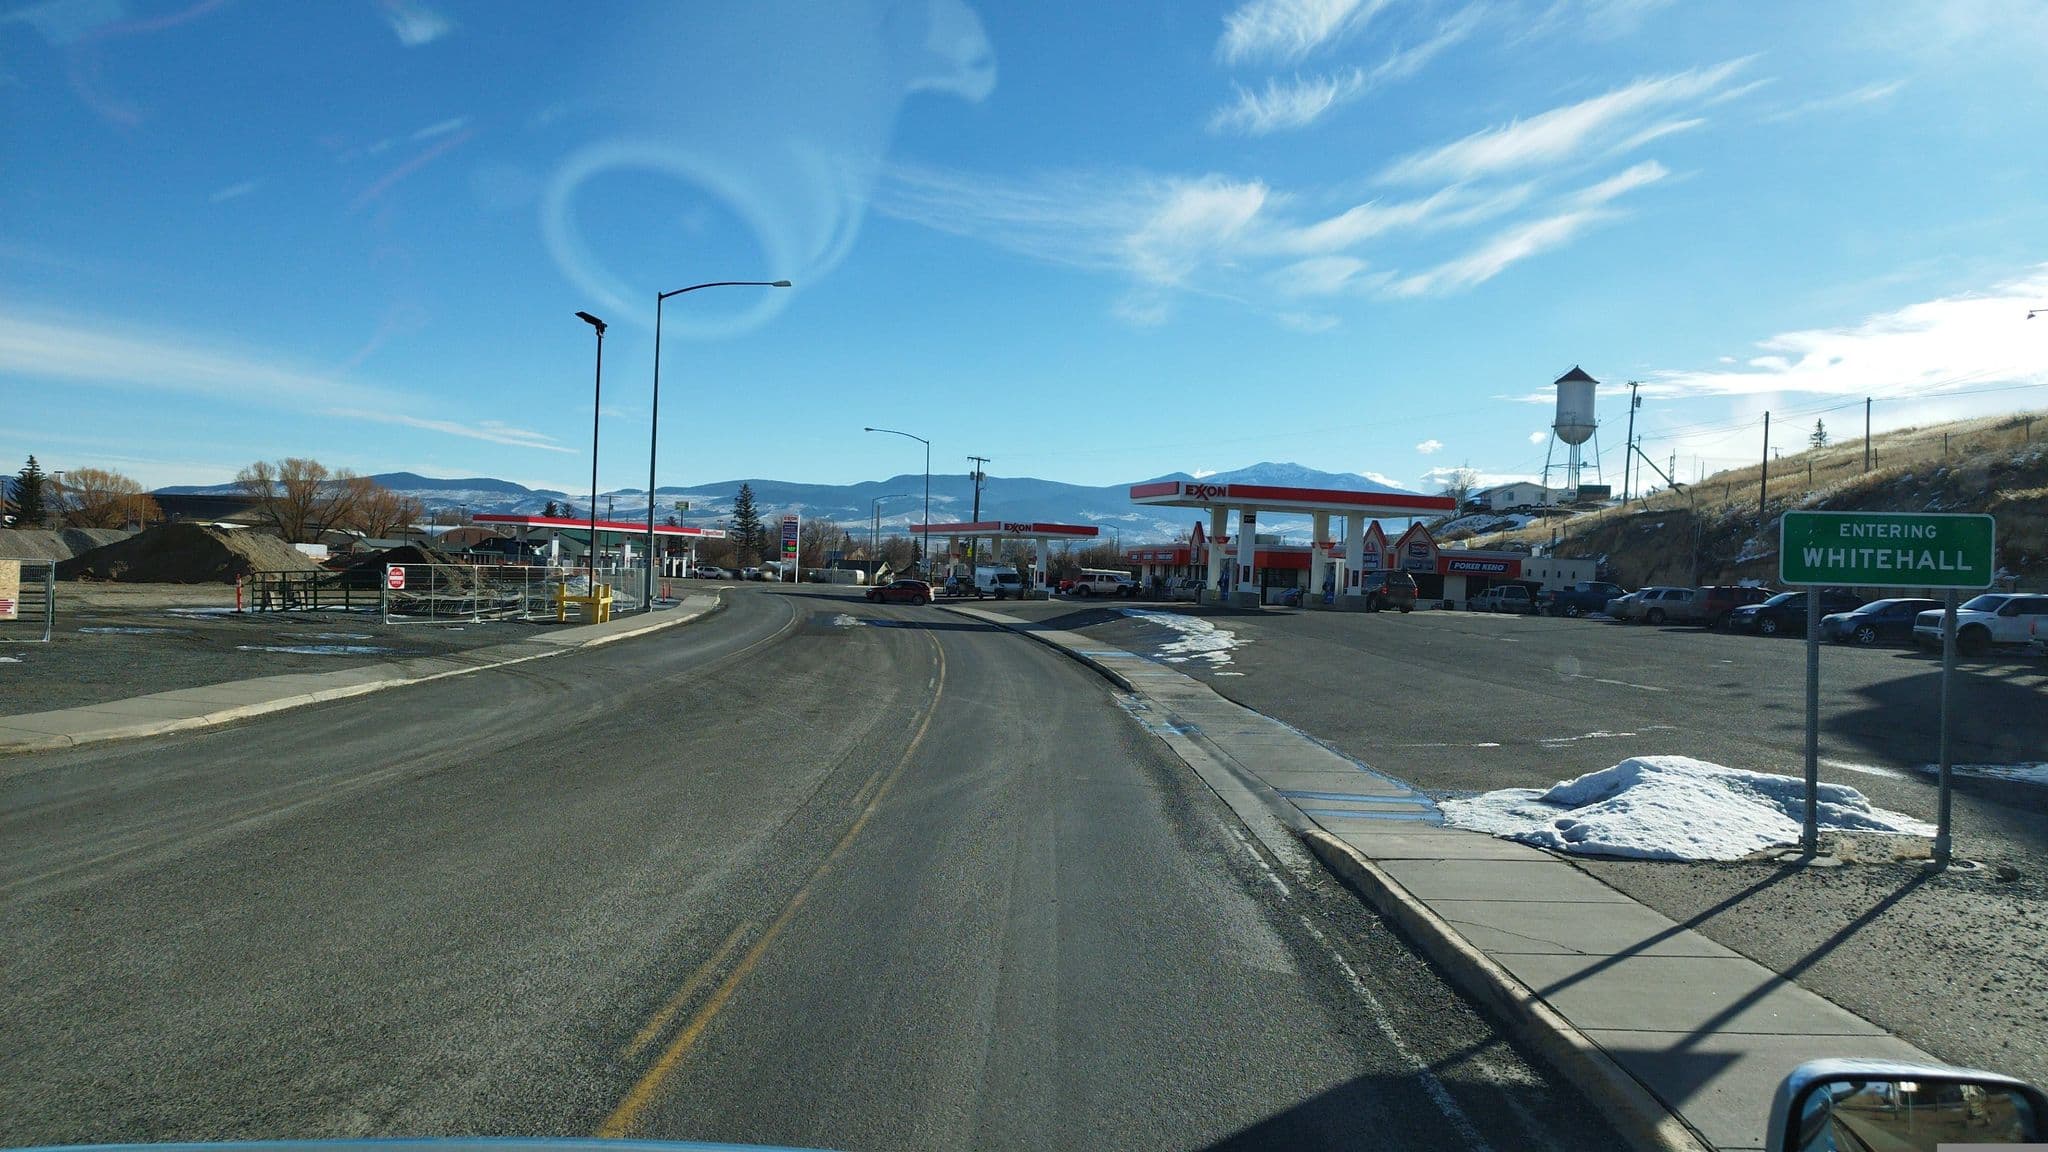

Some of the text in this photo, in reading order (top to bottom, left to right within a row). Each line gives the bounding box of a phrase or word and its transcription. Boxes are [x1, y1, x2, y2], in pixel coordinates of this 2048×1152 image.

[1185, 484, 1226, 500] EXXON
[1004, 522, 1032, 533] EXXON
[1839, 523, 1937, 539] ENTERING
[1453, 562, 1505, 571] POKER KENO
[1802, 547, 1973, 571] WHITEHALL
